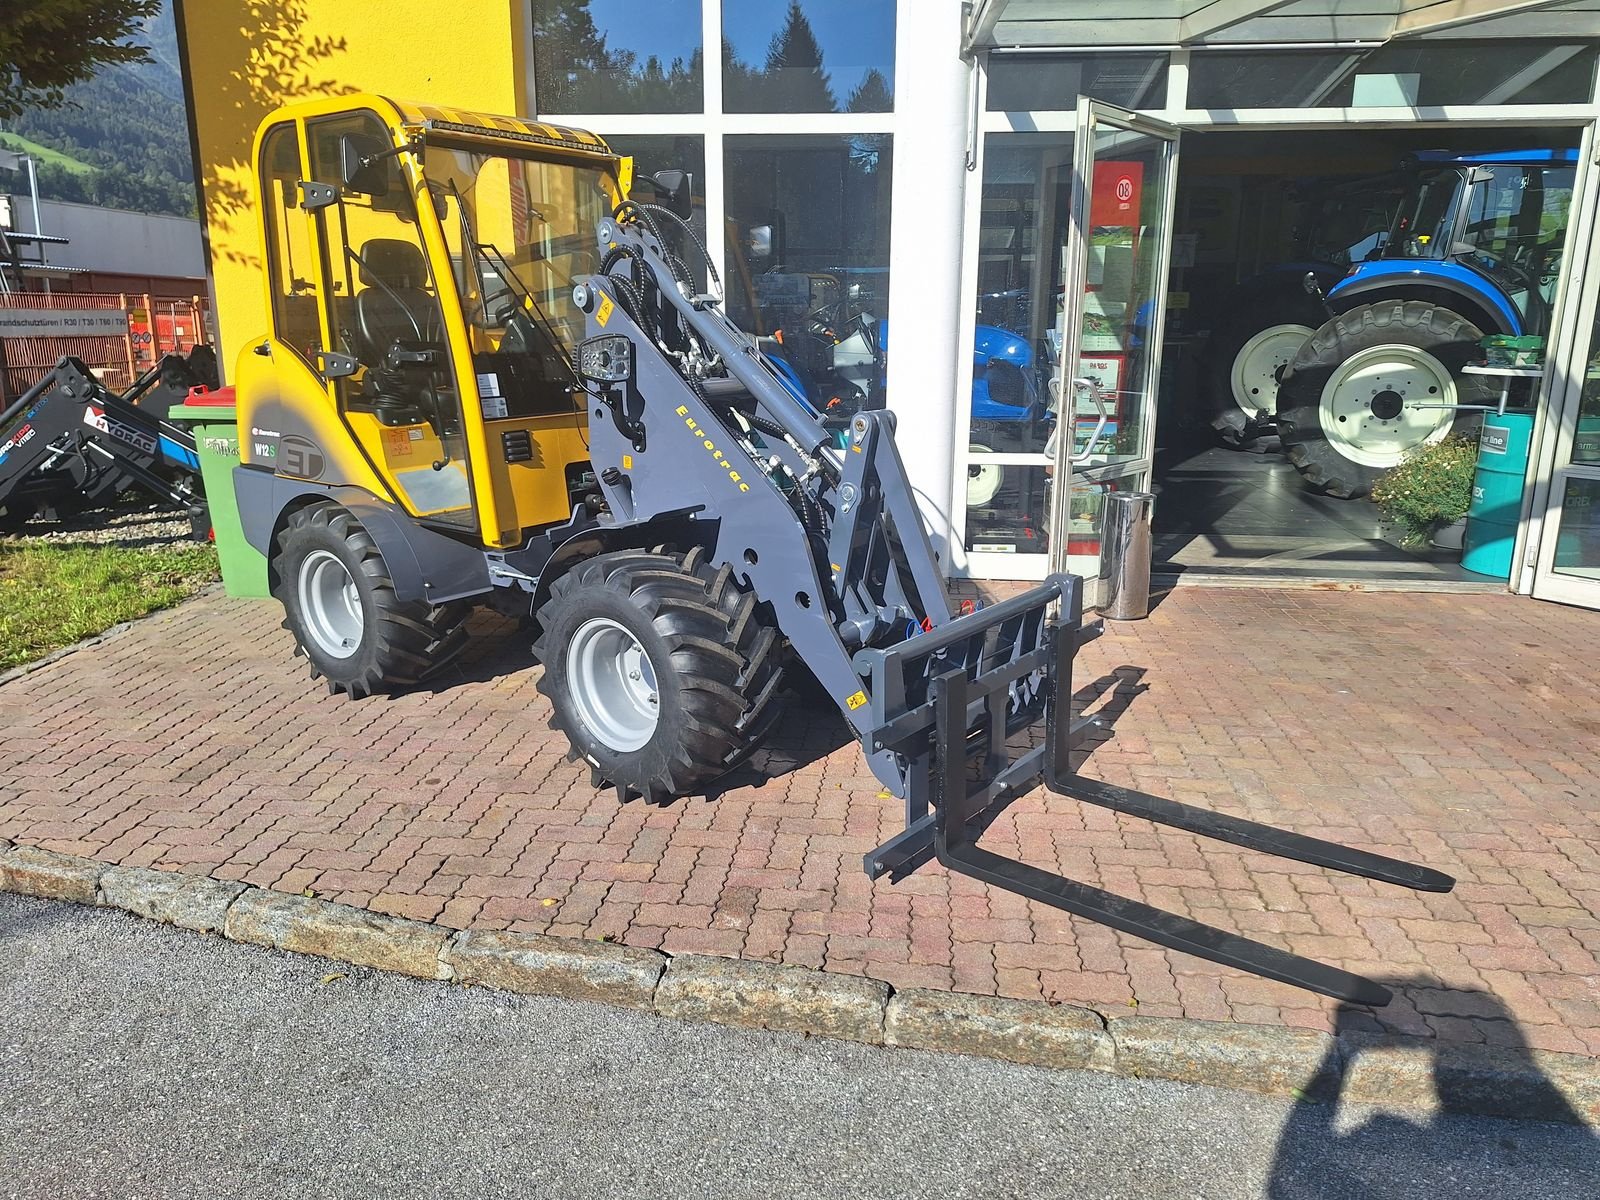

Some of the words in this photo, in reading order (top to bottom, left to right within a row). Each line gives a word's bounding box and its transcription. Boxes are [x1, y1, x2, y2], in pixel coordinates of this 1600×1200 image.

[64, 318, 77, 326] R30
[82, 318, 94, 326] T30
[96, 420, 152, 451] HYDRAC
[254, 443, 276, 457] W12S
[675, 405, 750, 493] Eurotrac
